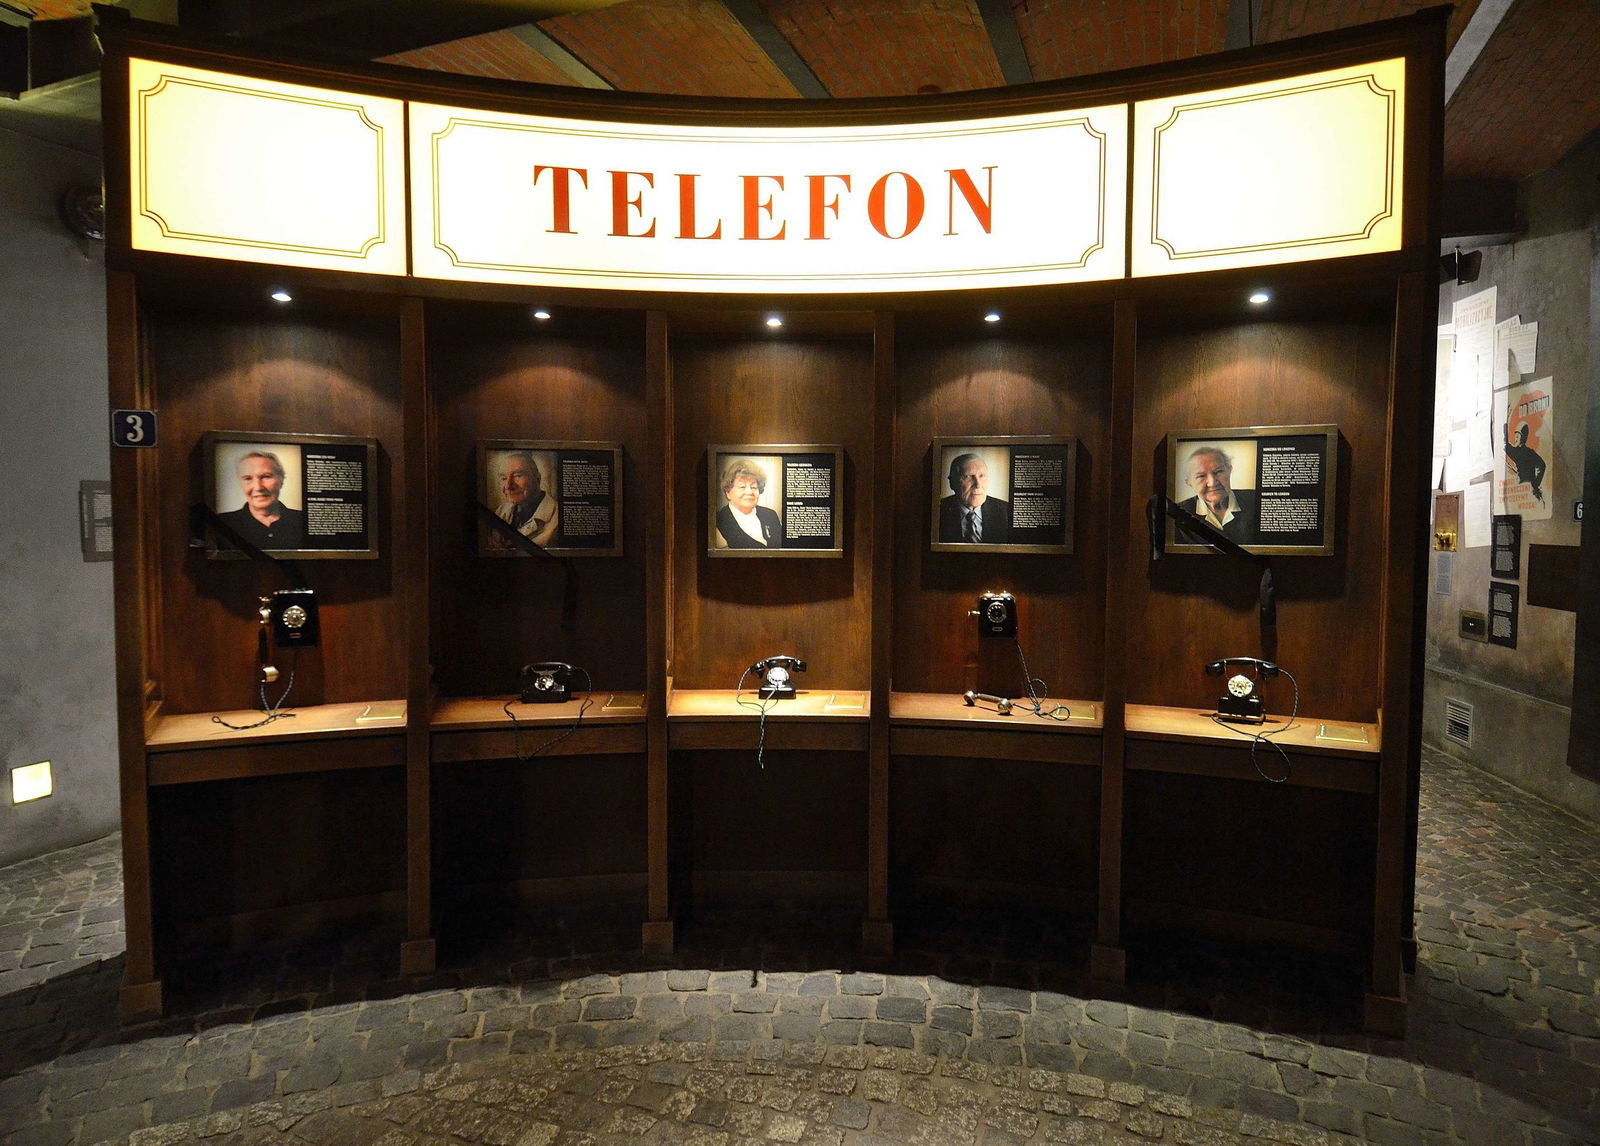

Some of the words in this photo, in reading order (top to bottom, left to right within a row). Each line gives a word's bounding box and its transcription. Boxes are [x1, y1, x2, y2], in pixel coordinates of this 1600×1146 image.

[533, 164, 999, 240] TELEFON
[126, 415, 144, 443] 3
[1577, 503, 1583, 519] 6
